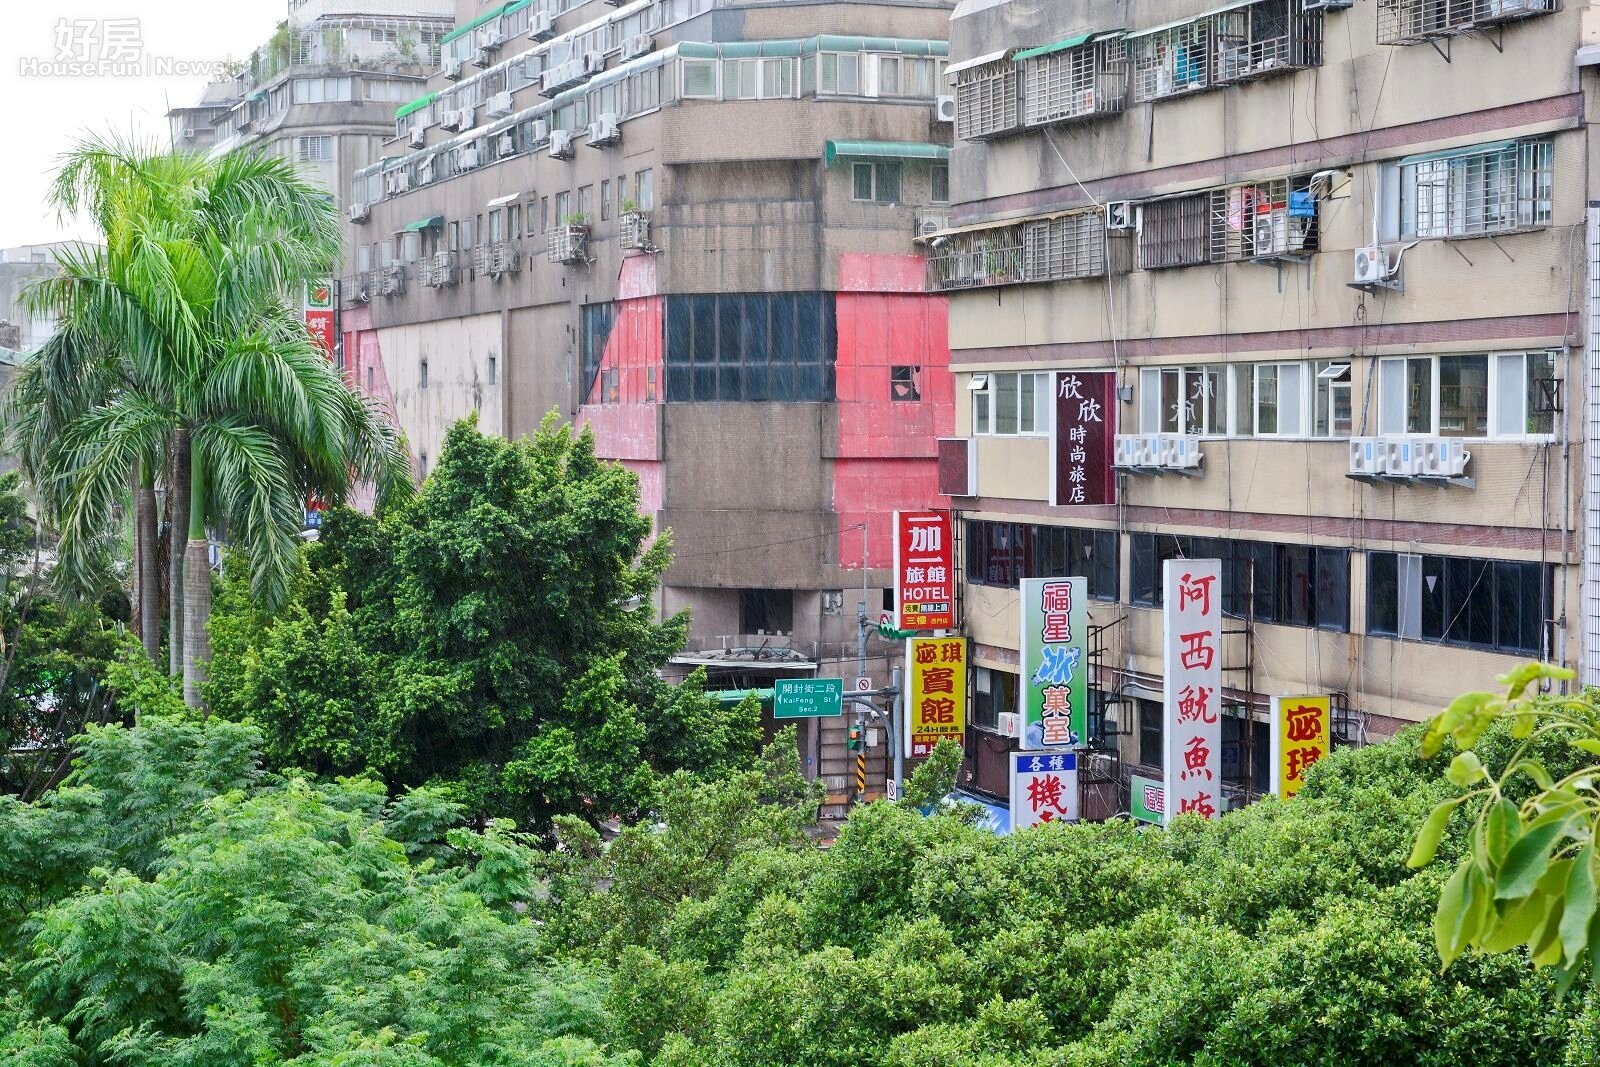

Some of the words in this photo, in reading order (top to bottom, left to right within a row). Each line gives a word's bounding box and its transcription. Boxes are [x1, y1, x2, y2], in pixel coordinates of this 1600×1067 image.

[1058, 374, 1103, 503] 欣欣時尚旅店
[907, 514, 944, 564] 一加一
[905, 565, 947, 584] 旅館
[903, 586, 950, 601] HOTEL
[905, 615, 928, 625] 三樓
[1038, 581, 1075, 746] 福星冰菓室
[782, 683, 837, 694] 開封街二段
[921, 667, 956, 725] 賓館
[783, 697, 815, 705] KaiFeng
[1028, 756, 1065, 771] 各種
